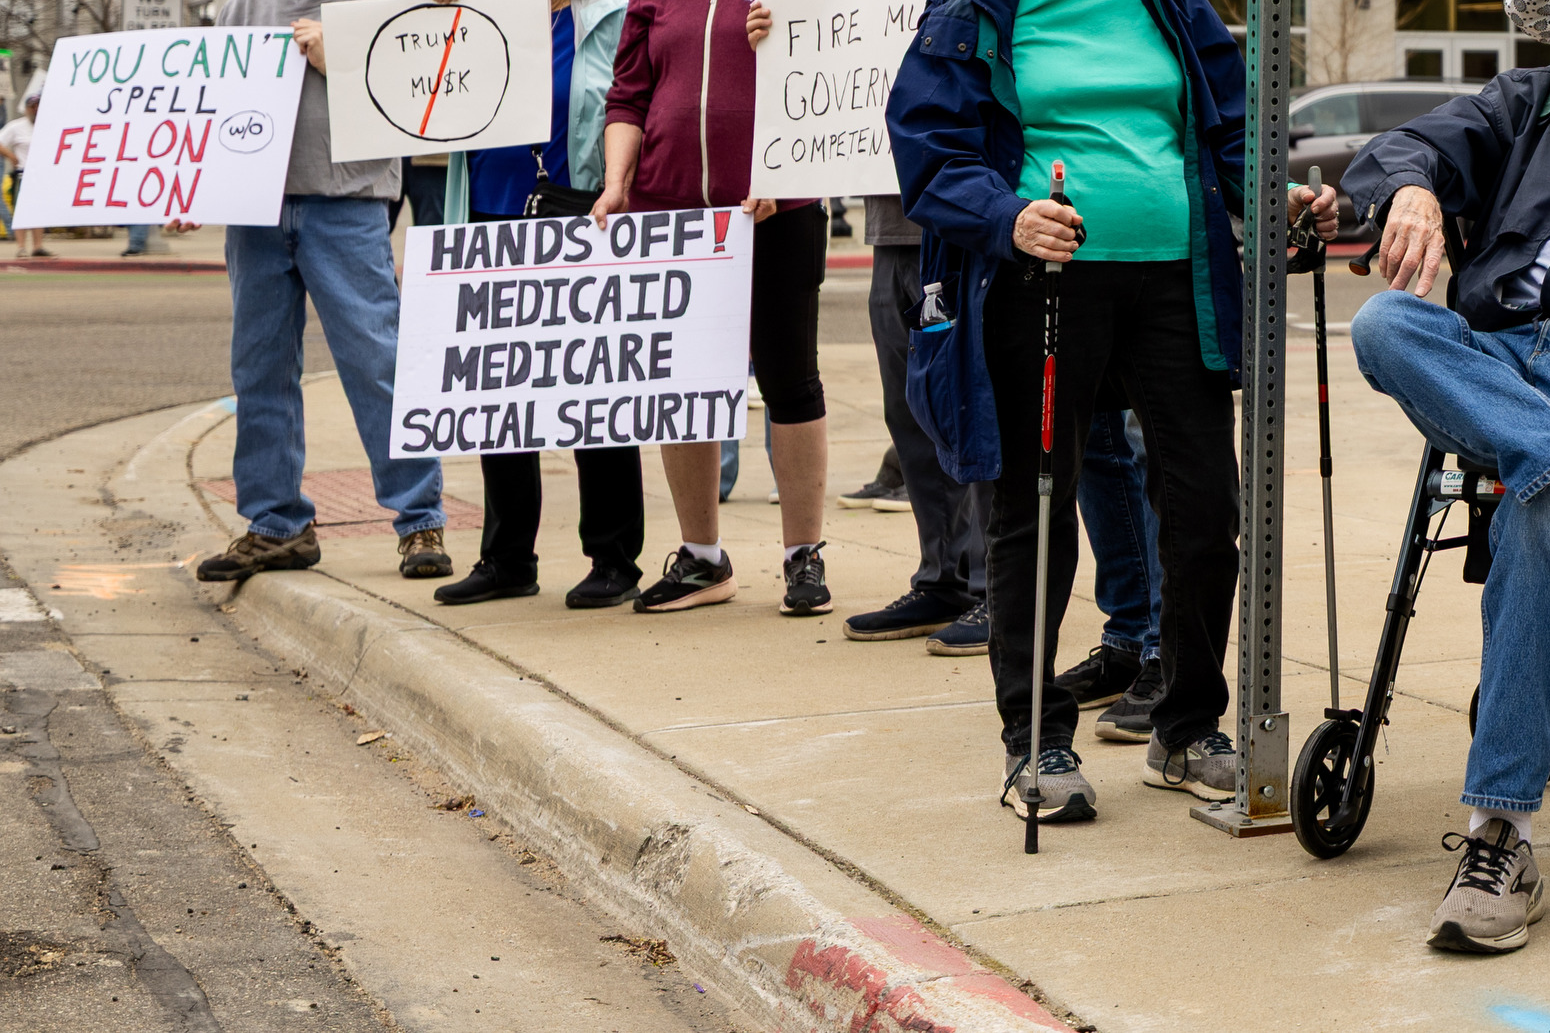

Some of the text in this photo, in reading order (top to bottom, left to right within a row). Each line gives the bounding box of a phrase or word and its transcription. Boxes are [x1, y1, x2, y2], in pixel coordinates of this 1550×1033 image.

[136, 7, 170, 18] TURN
[788, 3, 920, 57] FIRE MU
[70, 33, 295, 86] YOU CAN'T
[395, 26, 468, 52] TRUMP
[97, 85, 217, 114] SPELL
[411, 68, 470, 98] MU$K
[54, 118, 212, 165] FELON
[763, 127, 892, 170] COMPETEN
[72, 166, 202, 216] ELON
[430, 209, 732, 271] HANDS OFF!
[455, 269, 692, 333] MEDICAID
[441, 331, 673, 393] MEDICARE
[401, 389, 744, 453] SOCIAL SECURITY
[1445, 472, 1464, 480] CAR
